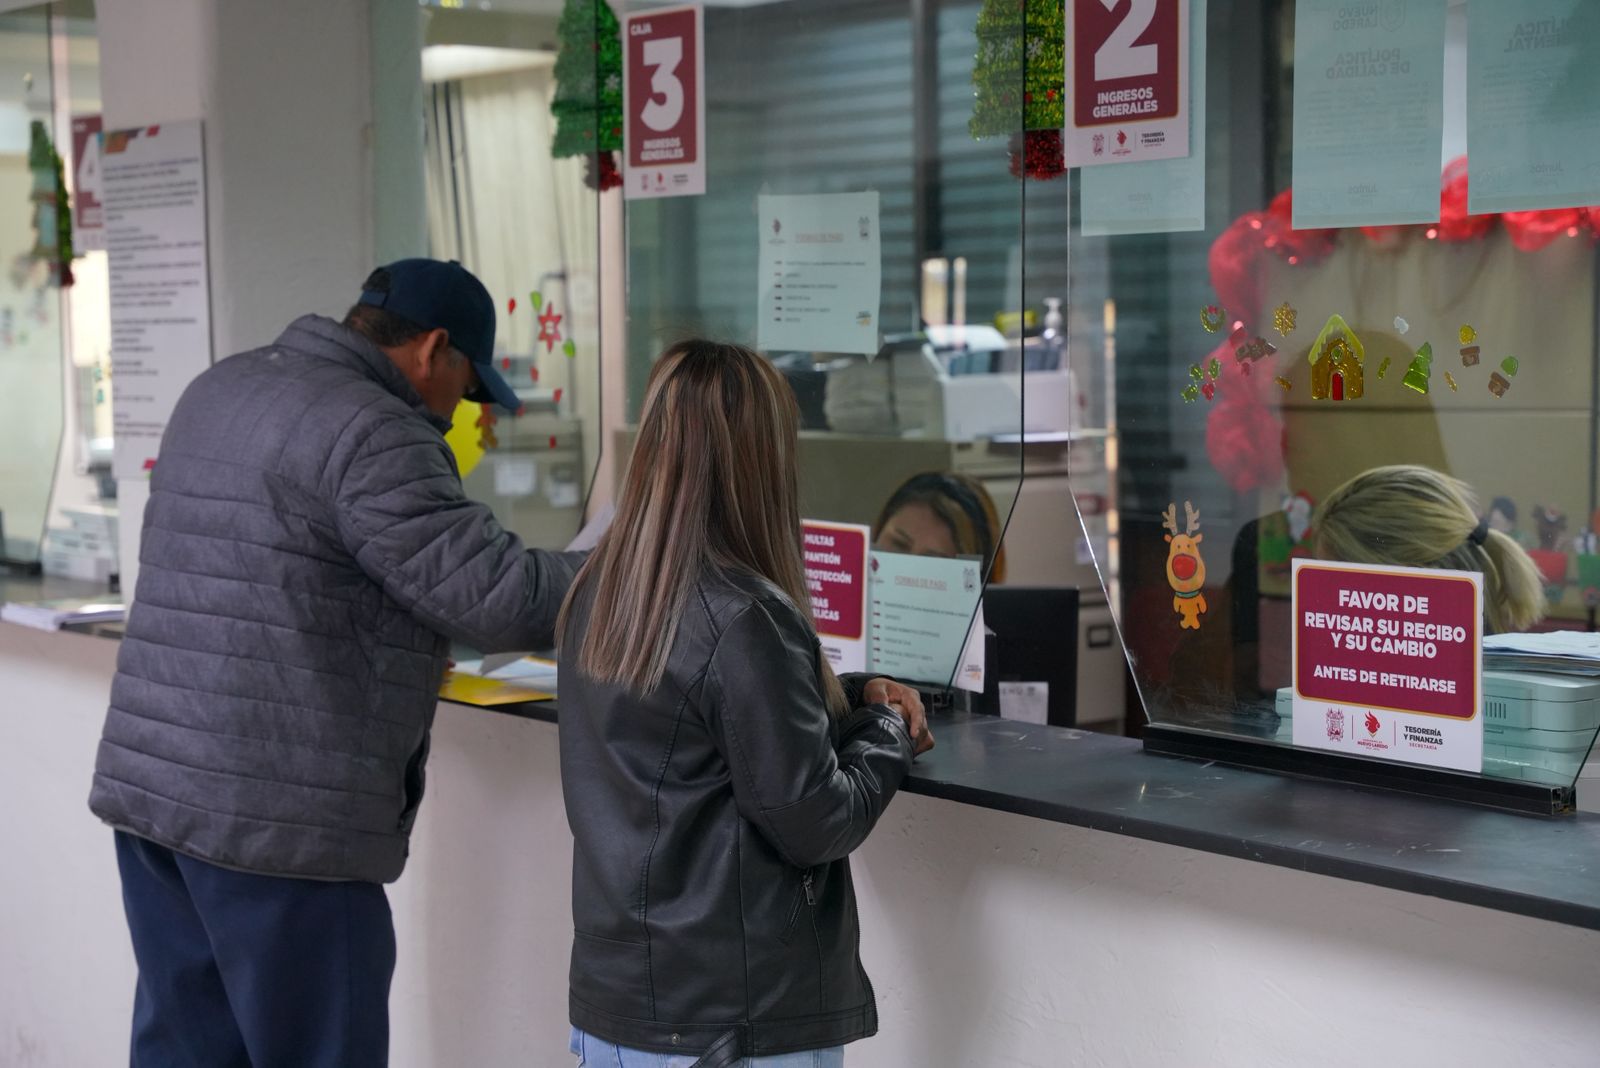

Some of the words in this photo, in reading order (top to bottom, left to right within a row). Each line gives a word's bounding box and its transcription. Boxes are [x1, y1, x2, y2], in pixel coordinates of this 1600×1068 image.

[1094, 0, 1158, 82] 2
[640, 36, 684, 132] 3
[1097, 86, 1154, 105] INGRESOS
[1093, 99, 1158, 118] GENERALES
[805, 533, 835, 547] MULTAS
[1338, 589, 1399, 613] FAVOR
[1403, 596, 1429, 615] DE
[1305, 612, 1374, 634] REVISAR
[1377, 619, 1400, 637] SU
[1403, 622, 1466, 643] RECIBO
[1331, 632, 1343, 648] Y
[1345, 634, 1367, 651] SU
[1370, 638, 1437, 659] CAMBIO
[1313, 665, 1357, 682] ANTES
[1359, 671, 1377, 685] DE
[1380, 673, 1457, 694] RETIRARSE
[1404, 725, 1442, 737] TESORERÍA
[1409, 734, 1443, 746] FINANZAS
